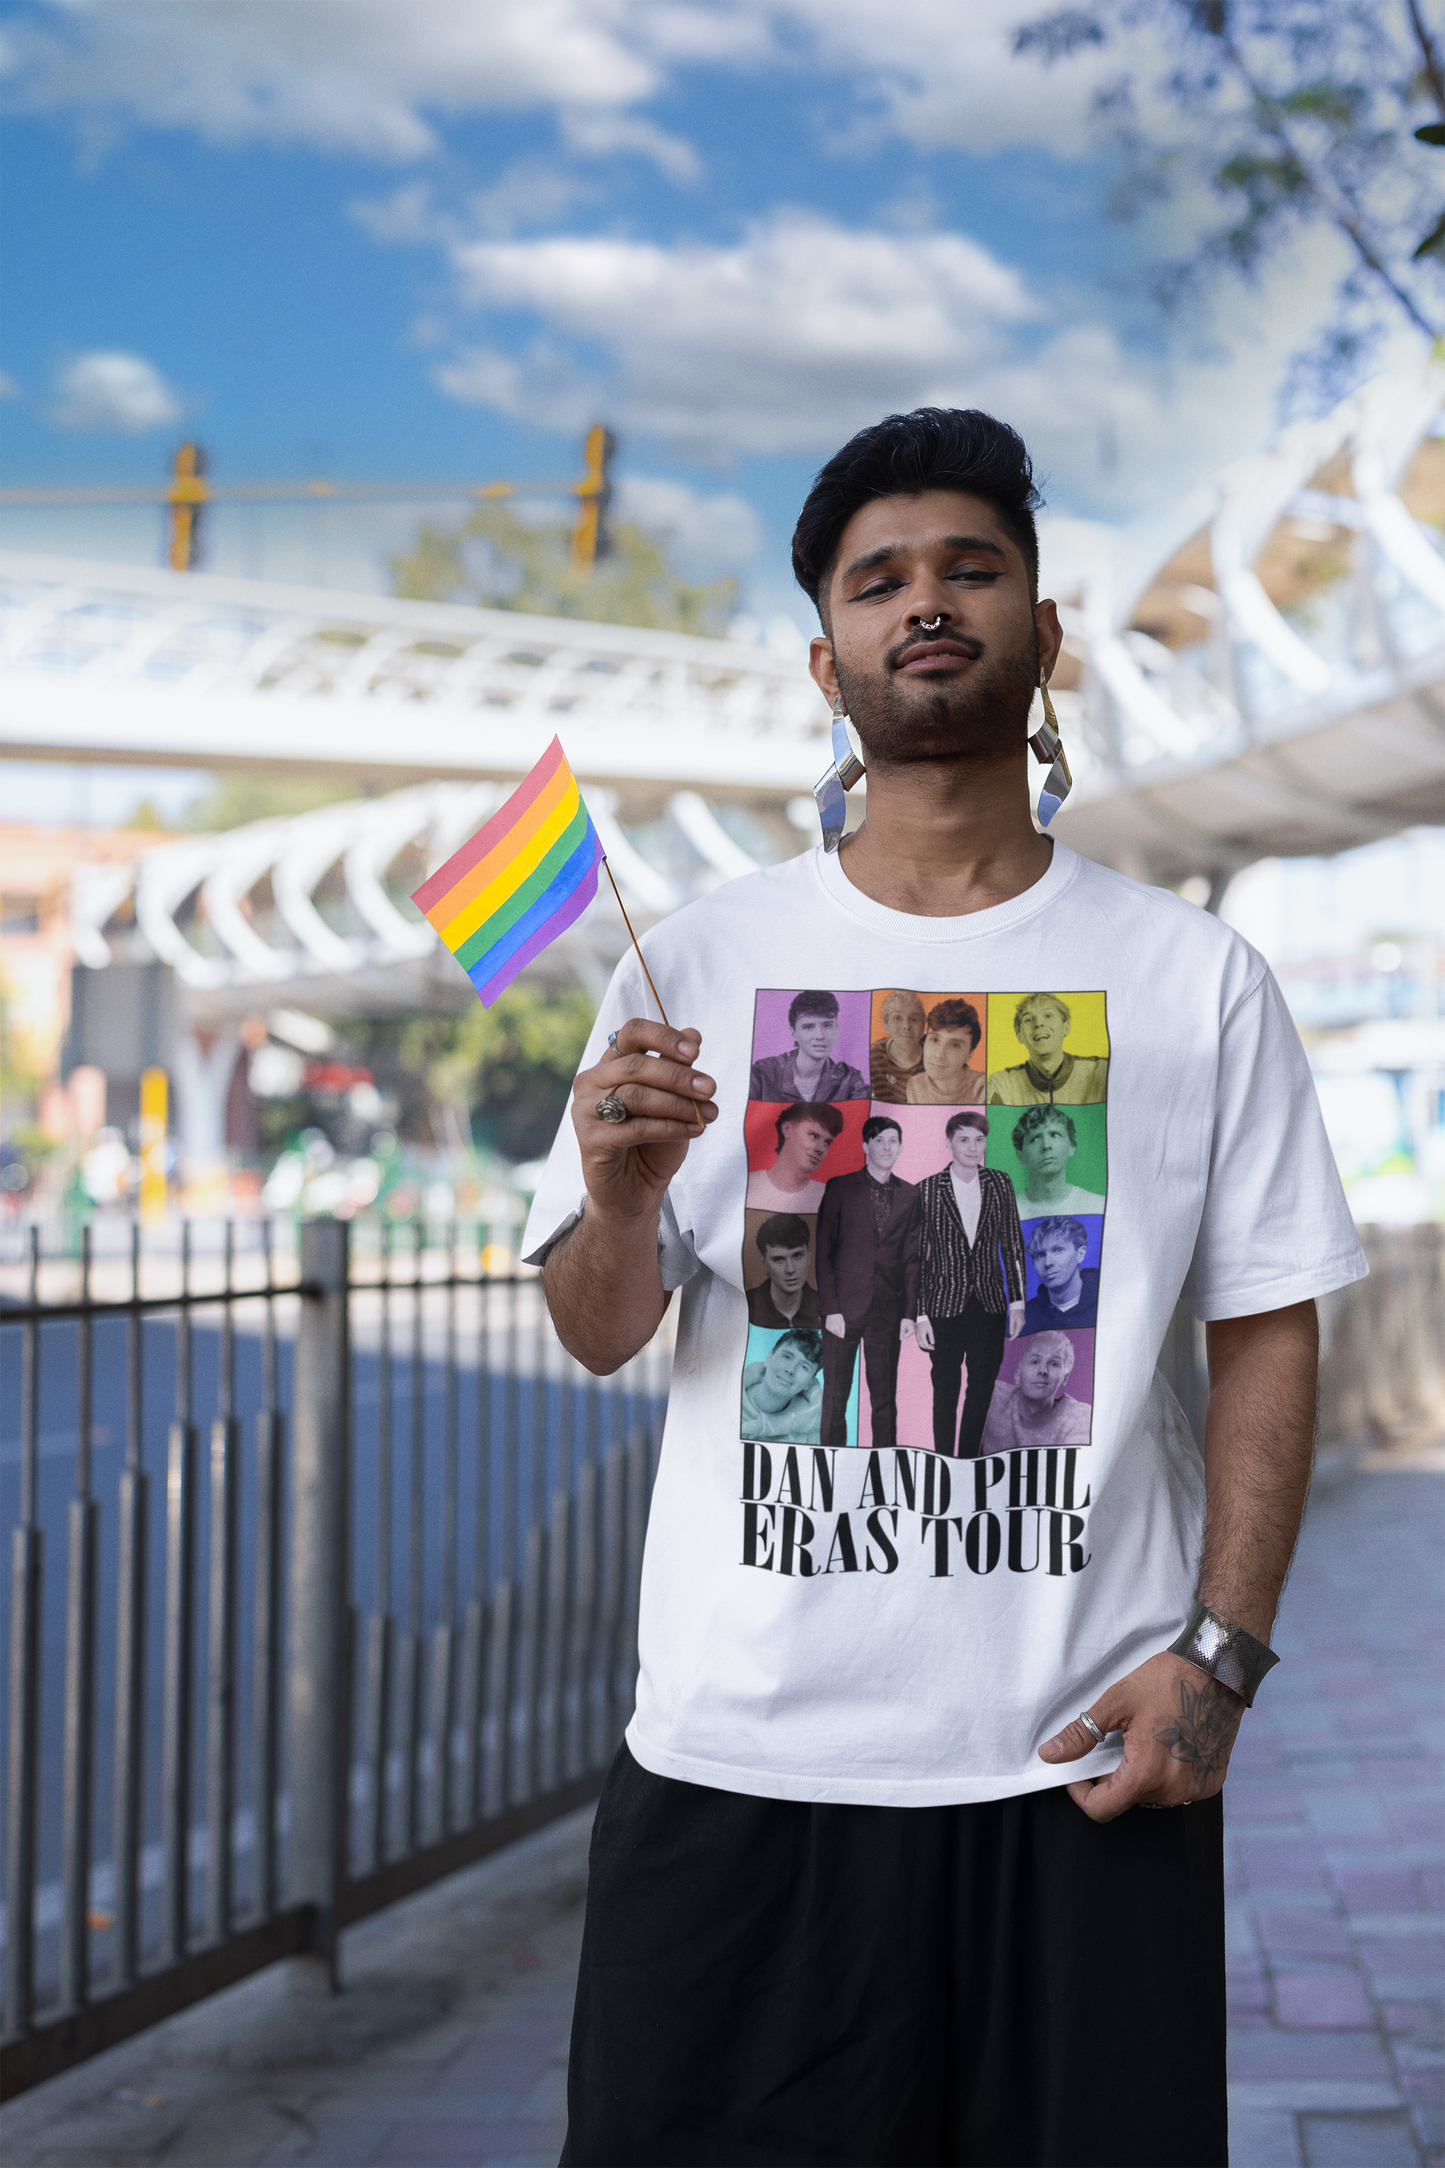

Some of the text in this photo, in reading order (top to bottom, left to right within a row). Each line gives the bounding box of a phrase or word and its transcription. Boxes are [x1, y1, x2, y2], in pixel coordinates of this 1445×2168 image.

[739, 1441, 1091, 1517] DAN AND PHIL
[739, 1501, 1092, 1578] ERAS TOUR
